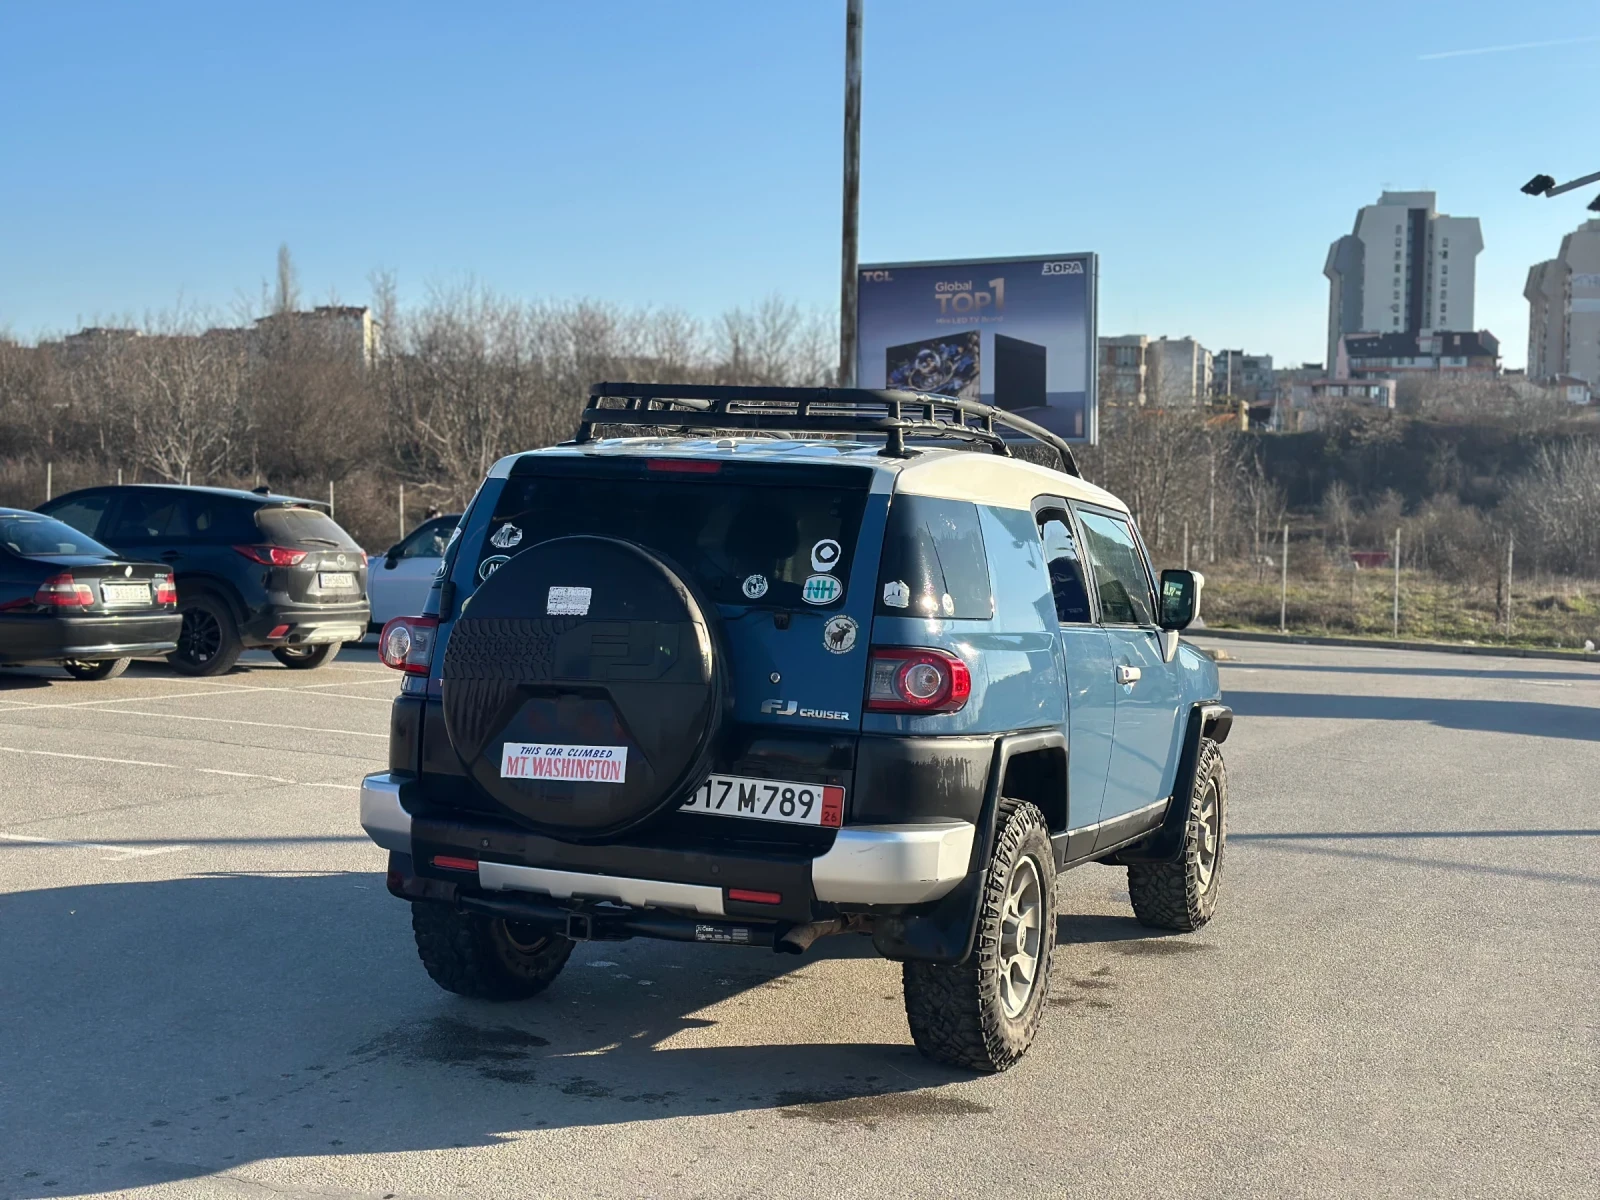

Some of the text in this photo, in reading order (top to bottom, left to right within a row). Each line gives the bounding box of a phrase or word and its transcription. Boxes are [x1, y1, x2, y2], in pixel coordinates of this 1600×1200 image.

[863, 271, 893, 282] TCL
[935, 280, 972, 292] Global
[806, 580, 835, 598] NH
[760, 699, 850, 721] FJ CRUISER
[520, 746, 613, 758] THIS CAR CLIMBED
[506, 756, 622, 780] MT. WASHINGTON
[823, 811, 838, 823] 26
